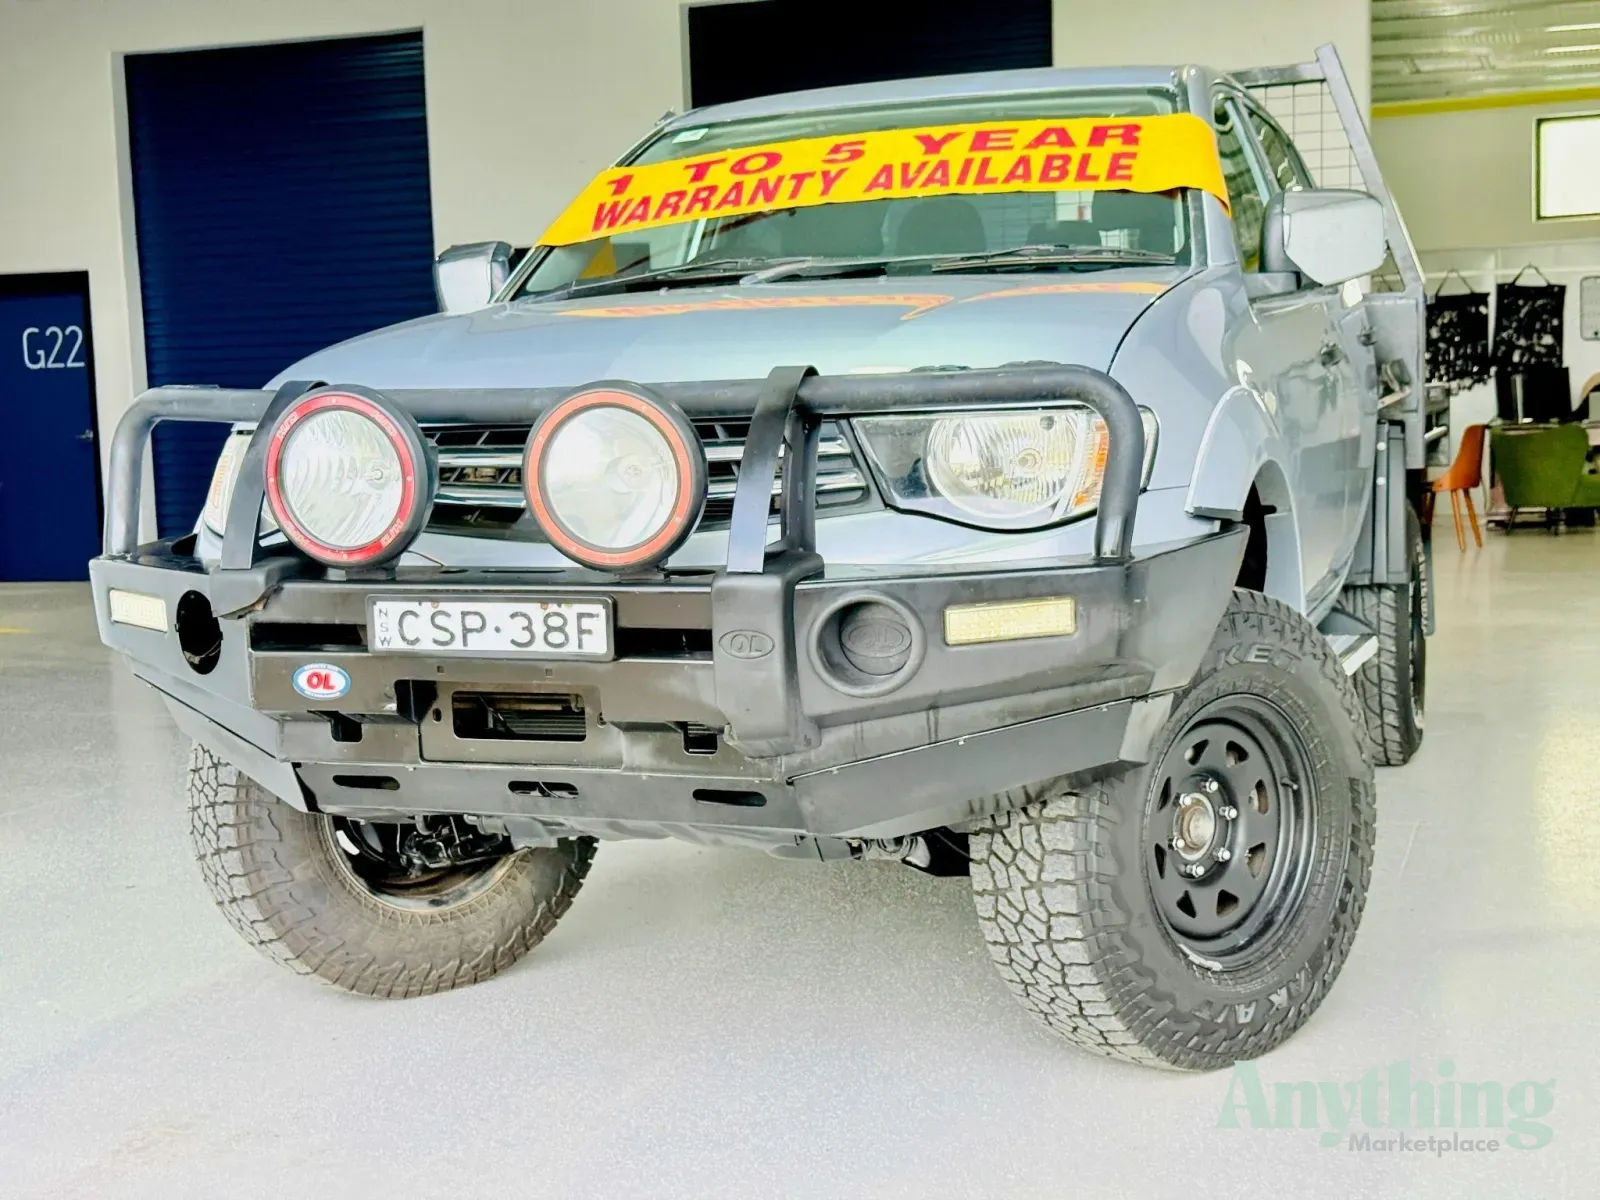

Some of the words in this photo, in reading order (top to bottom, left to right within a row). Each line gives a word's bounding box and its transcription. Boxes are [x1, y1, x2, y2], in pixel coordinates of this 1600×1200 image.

[607, 174, 635, 197] 1
[683, 151, 783, 184] TO
[821, 140, 867, 165] 5
[914, 124, 1143, 155] YEAR
[591, 167, 849, 232] WARRANTY
[862, 151, 1139, 193] AVAILABLE
[22, 325, 86, 370] G22
[306, 671, 336, 690] OL
